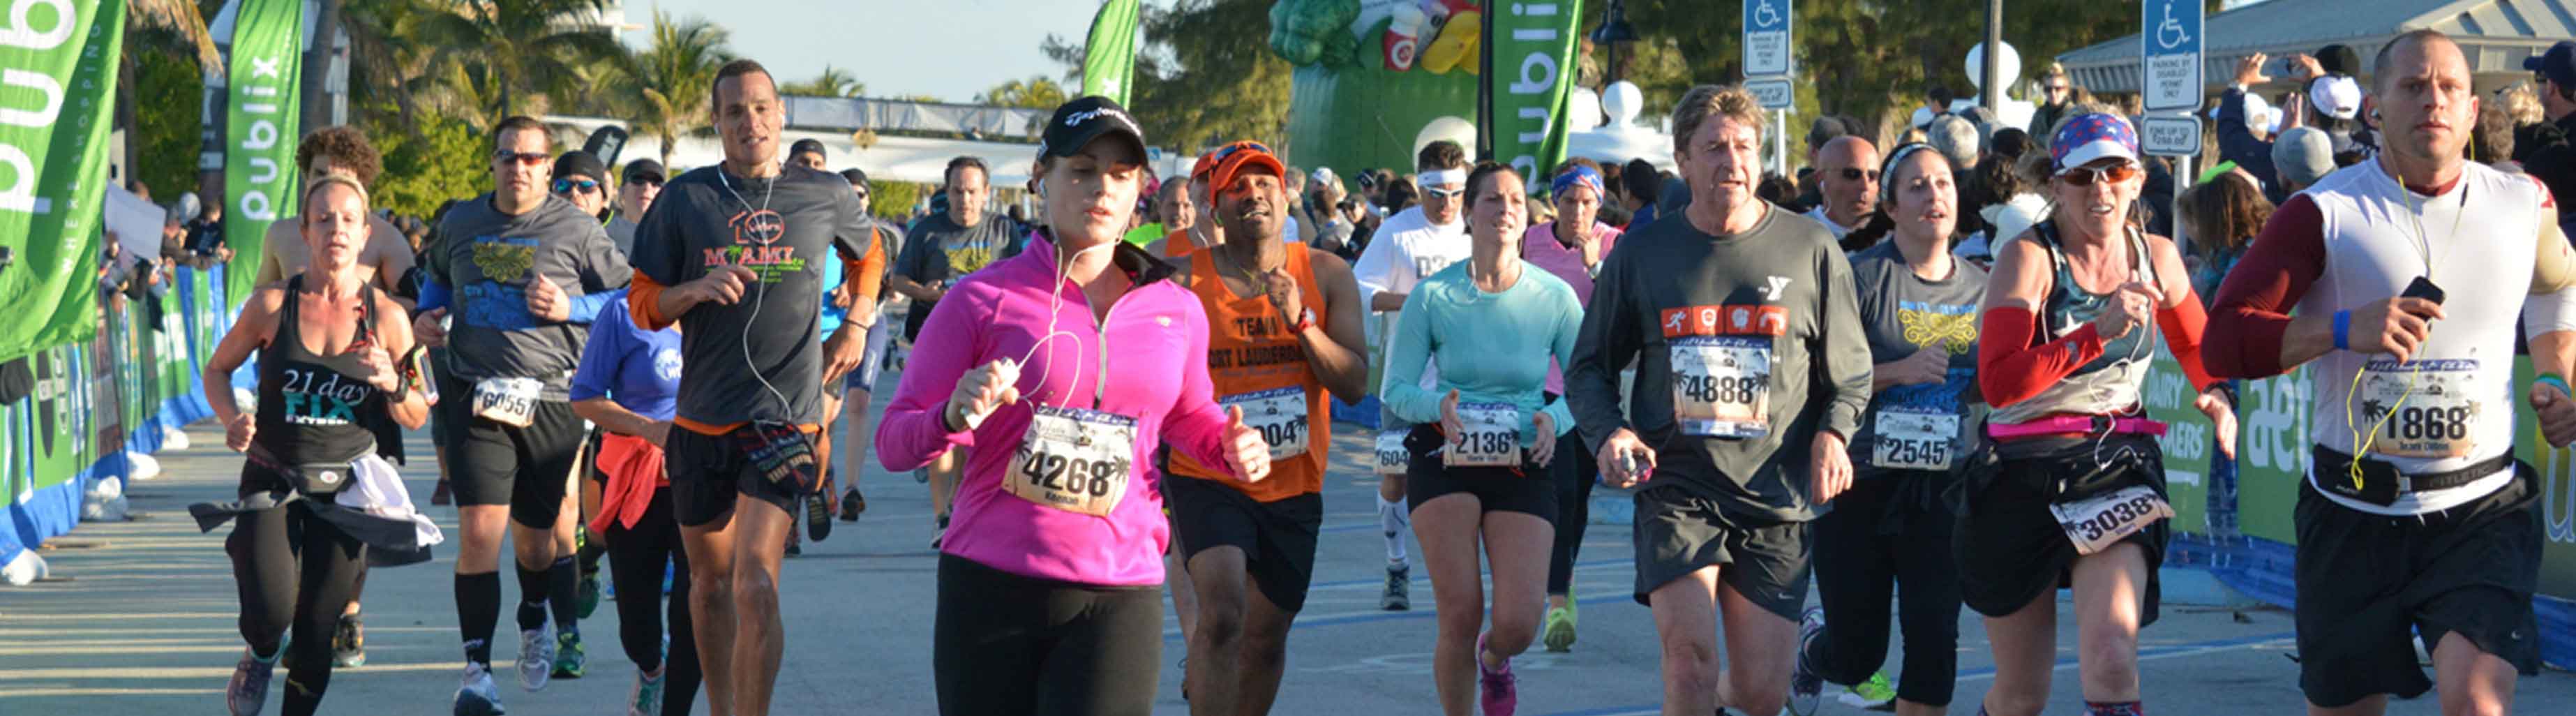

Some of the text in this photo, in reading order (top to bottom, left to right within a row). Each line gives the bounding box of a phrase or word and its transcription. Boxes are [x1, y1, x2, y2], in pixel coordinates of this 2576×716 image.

[240, 55, 279, 221] publix
[1235, 315, 1278, 337] TEAM
[1208, 348, 1231, 369] ORT
[281, 368, 371, 406] 21 day
[1686, 375, 1753, 405] 4888
[2386, 406, 2467, 440] 1868
[1455, 431, 1511, 454] 2136
[1887, 438, 1947, 465] 2545
[1022, 452, 1111, 497] 4268
[2081, 496, 2153, 542] 3038
